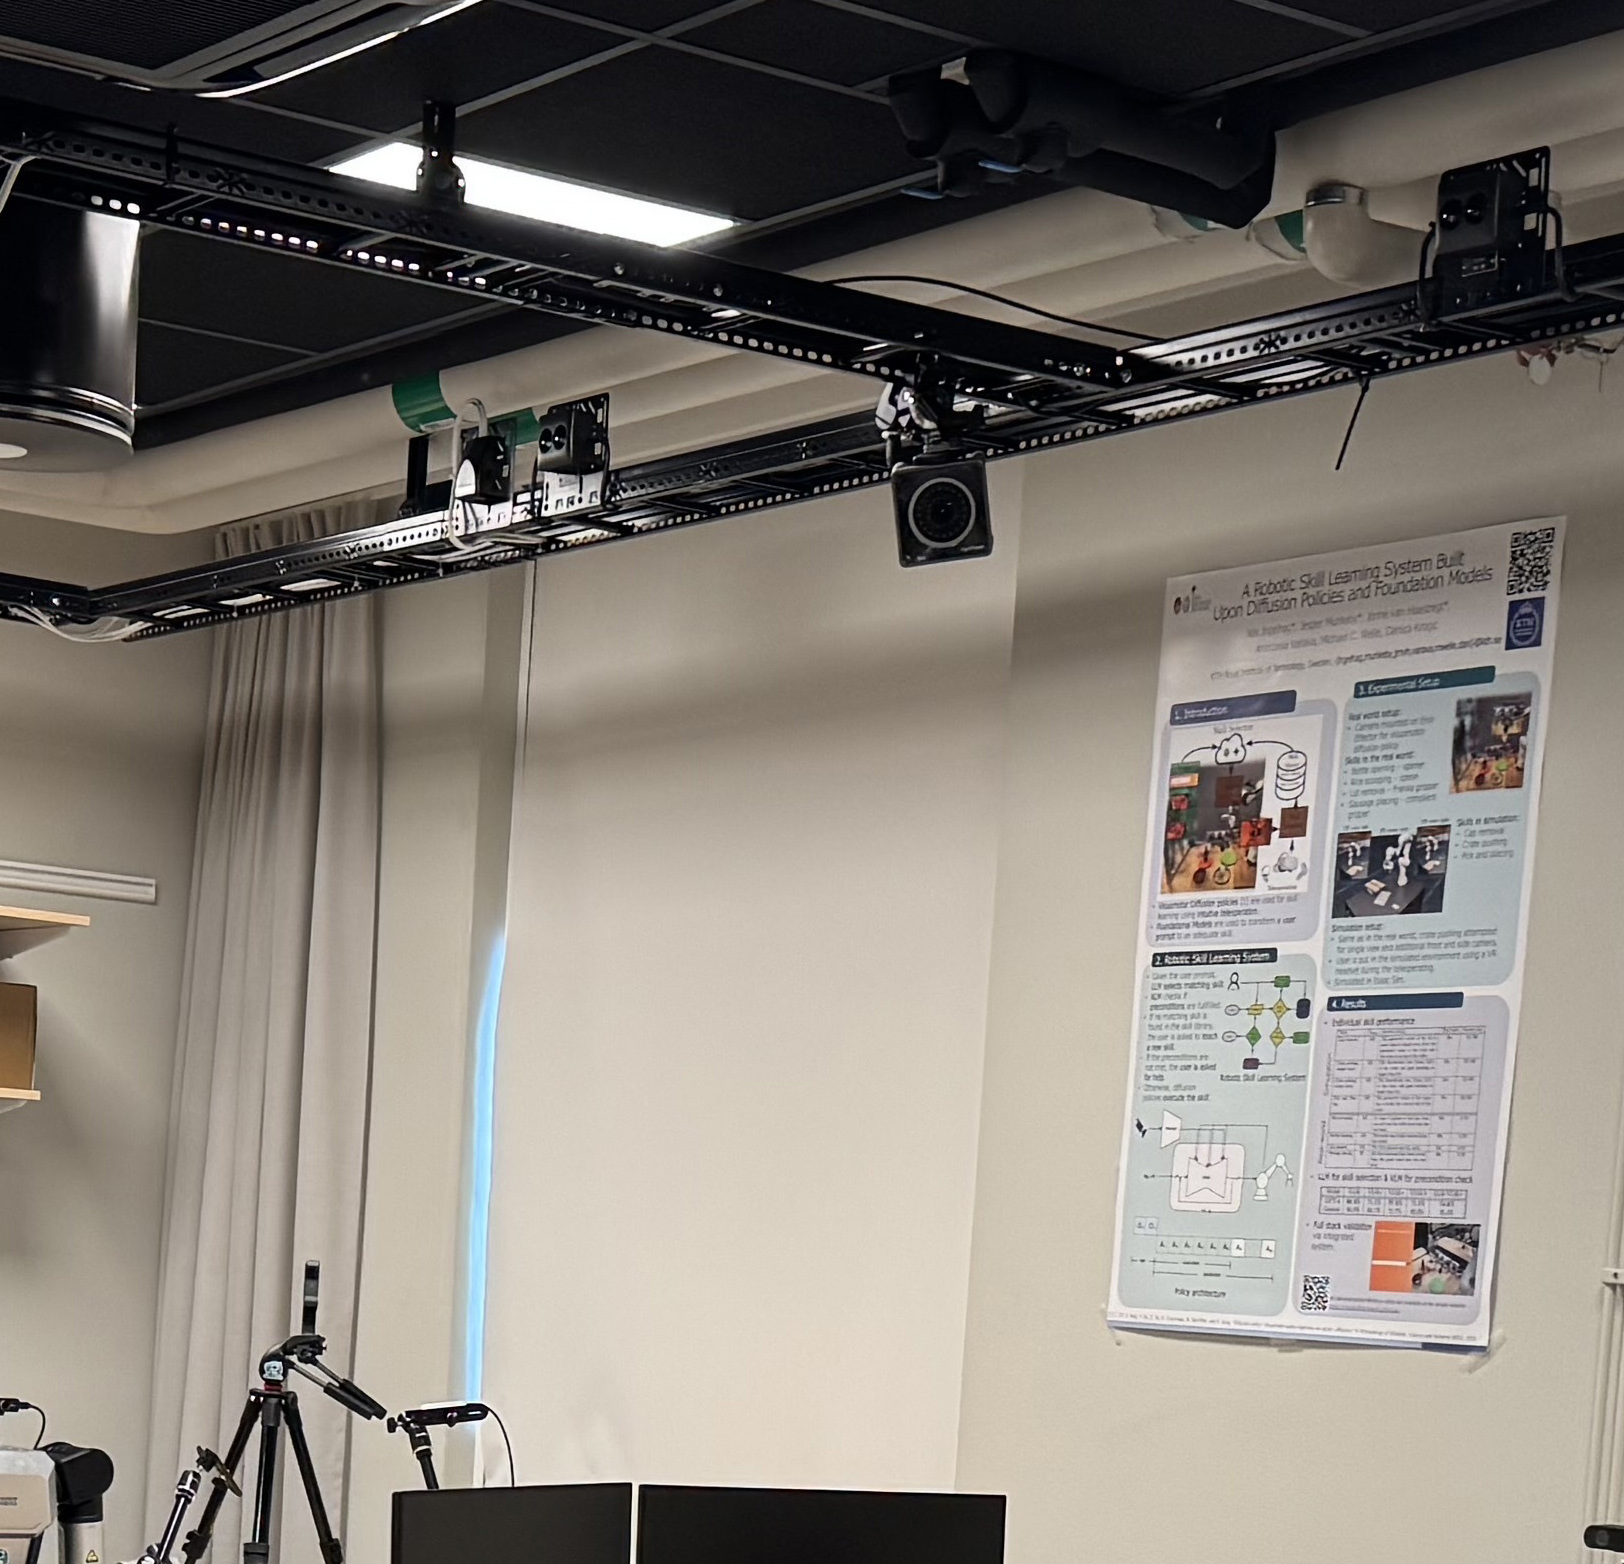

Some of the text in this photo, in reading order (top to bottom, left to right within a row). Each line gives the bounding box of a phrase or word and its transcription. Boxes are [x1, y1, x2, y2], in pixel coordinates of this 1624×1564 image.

[1213, 565, 1493, 623] Upon Diffusion Policies and Foundation Models
[1242, 584, 1250, 598] A
[1254, 579, 1295, 597] Robotic
[1329, 565, 1380, 585] Learning
[1384, 556, 1433, 579] System
